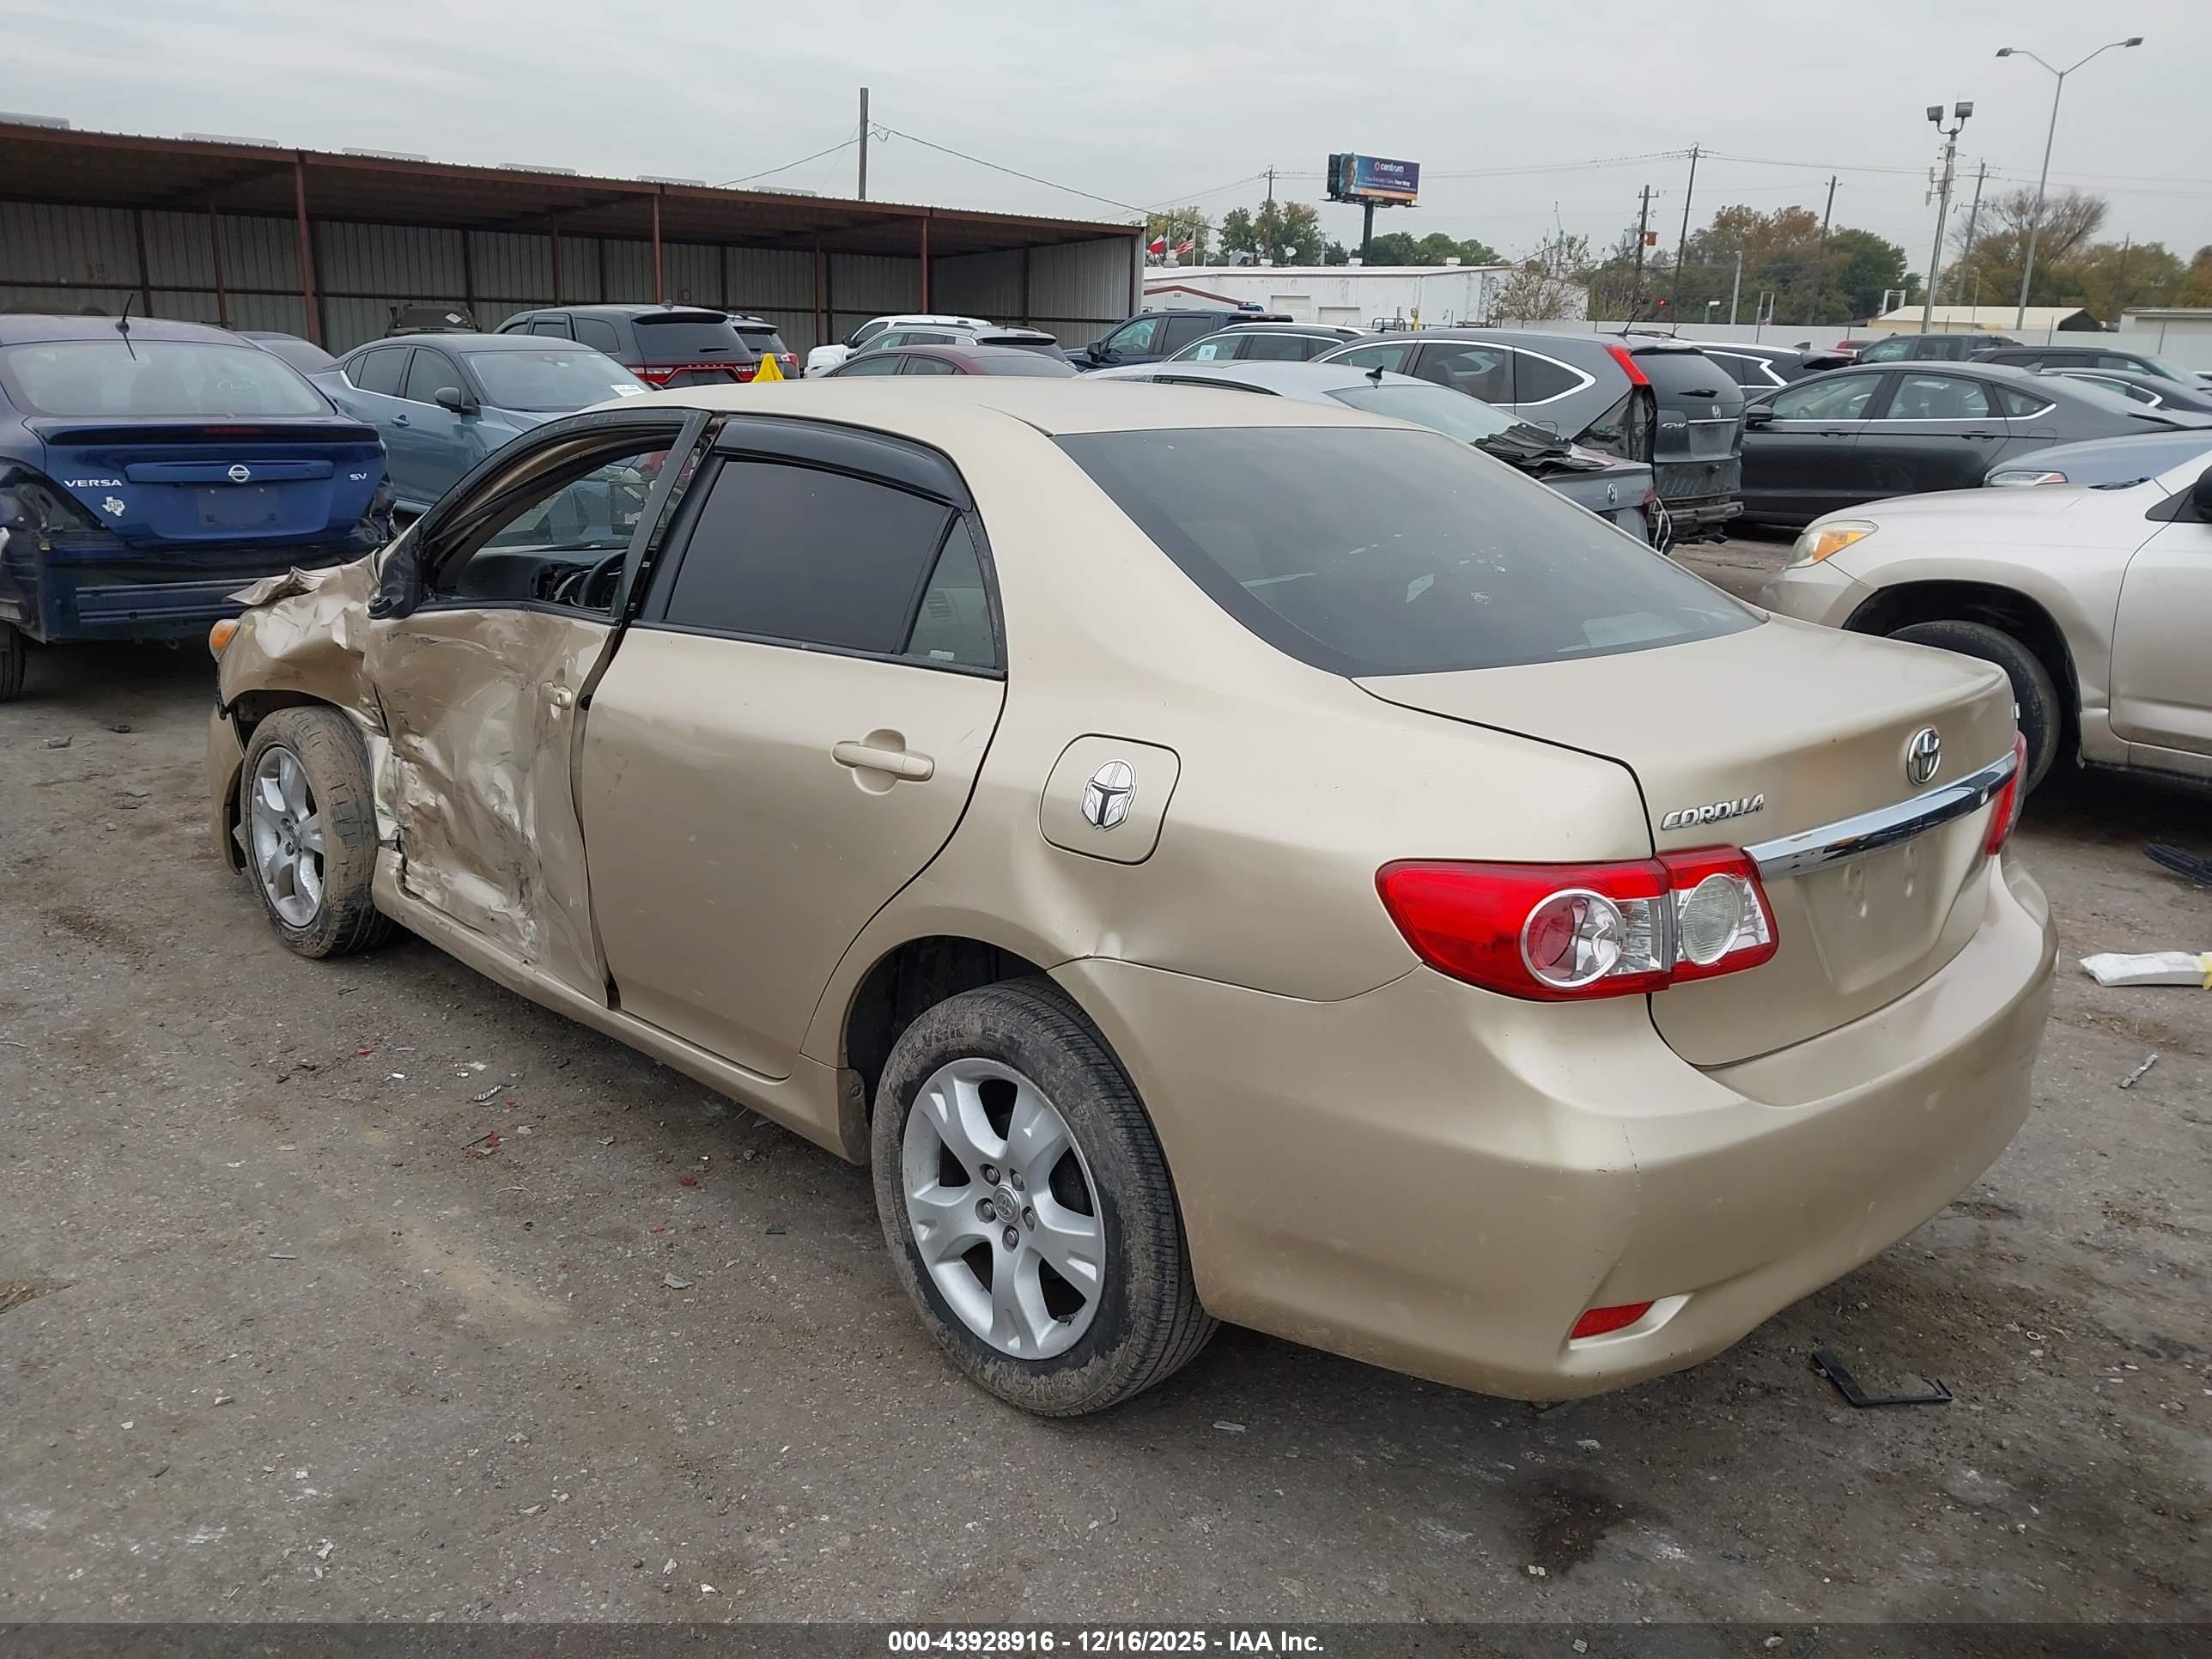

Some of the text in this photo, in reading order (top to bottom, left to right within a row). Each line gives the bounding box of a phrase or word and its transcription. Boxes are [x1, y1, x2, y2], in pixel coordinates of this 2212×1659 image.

[1381, 163, 1404, 173] centrum
[349, 472, 368, 481] SV
[64, 479, 123, 488] VERSA
[1661, 793, 1765, 830] COROLLA
